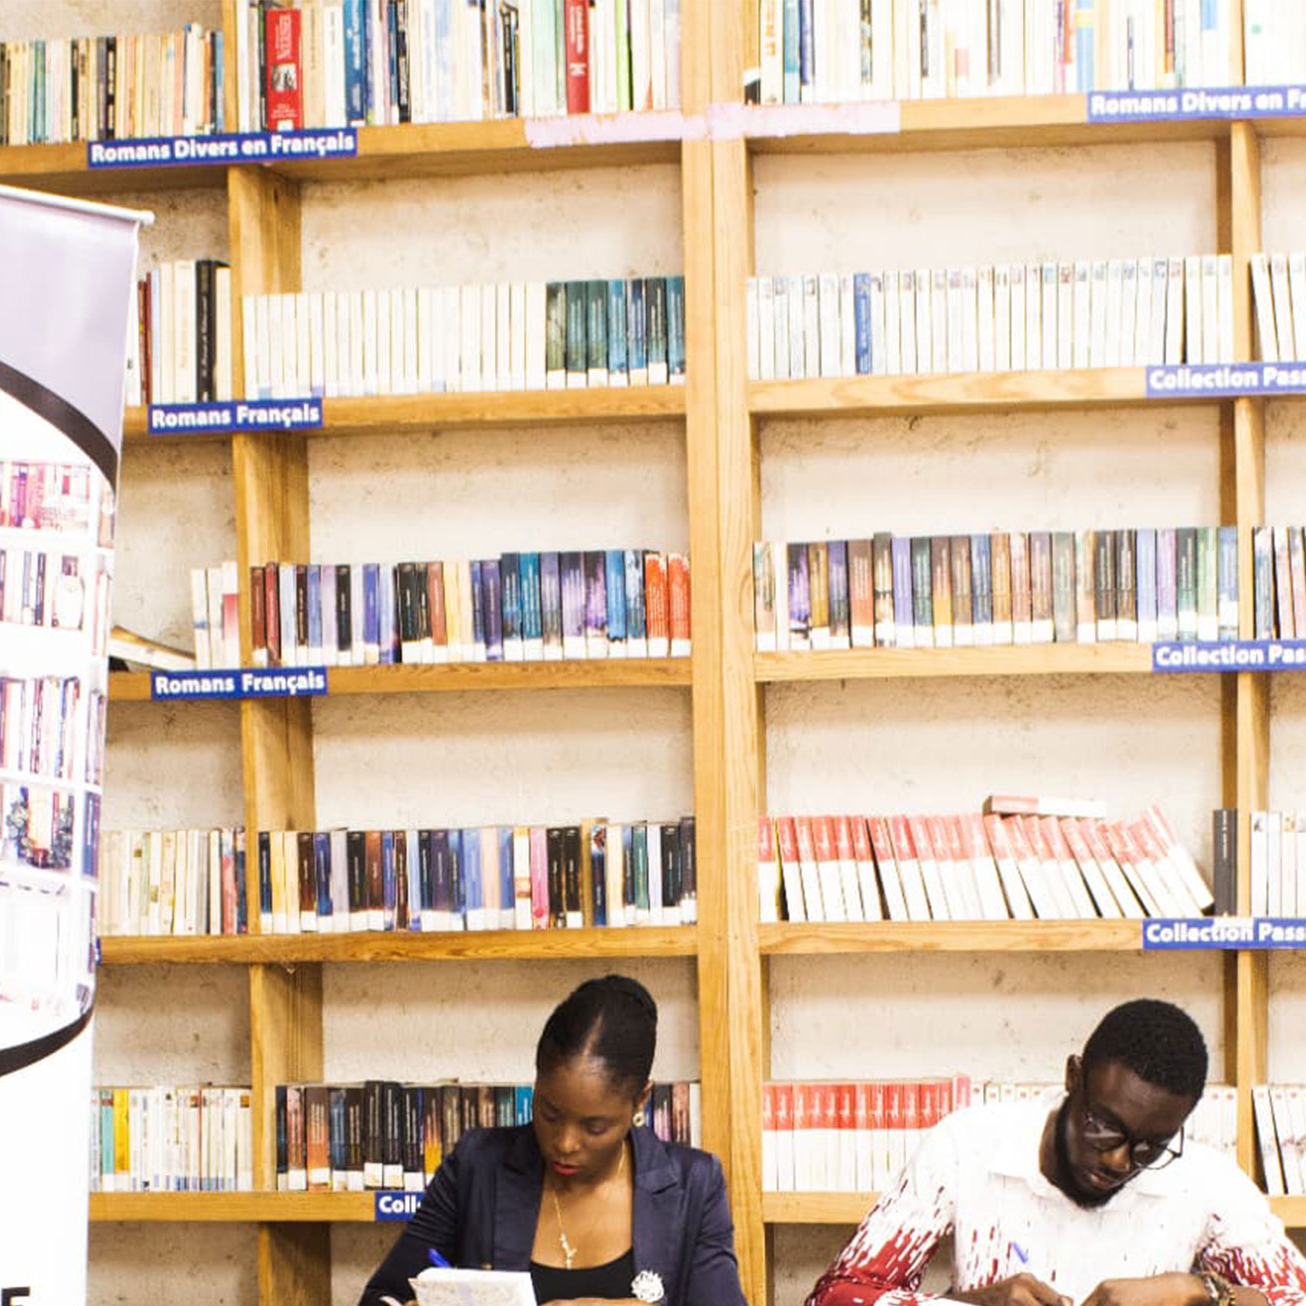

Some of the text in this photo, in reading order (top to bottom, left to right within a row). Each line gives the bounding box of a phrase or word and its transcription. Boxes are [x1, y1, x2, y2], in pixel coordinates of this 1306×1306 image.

[1091, 96, 1178, 116] Romans
[1182, 92, 1252, 113] Divers
[1255, 93, 1284, 109] en
[92, 132, 354, 163] Romans Divers en Français
[1149, 367, 1258, 390] Collection
[153, 402, 320, 428] Romans Français
[1155, 643, 1264, 666] Collection
[155, 671, 324, 696] Romans Français
[1147, 920, 1255, 944] Collection
